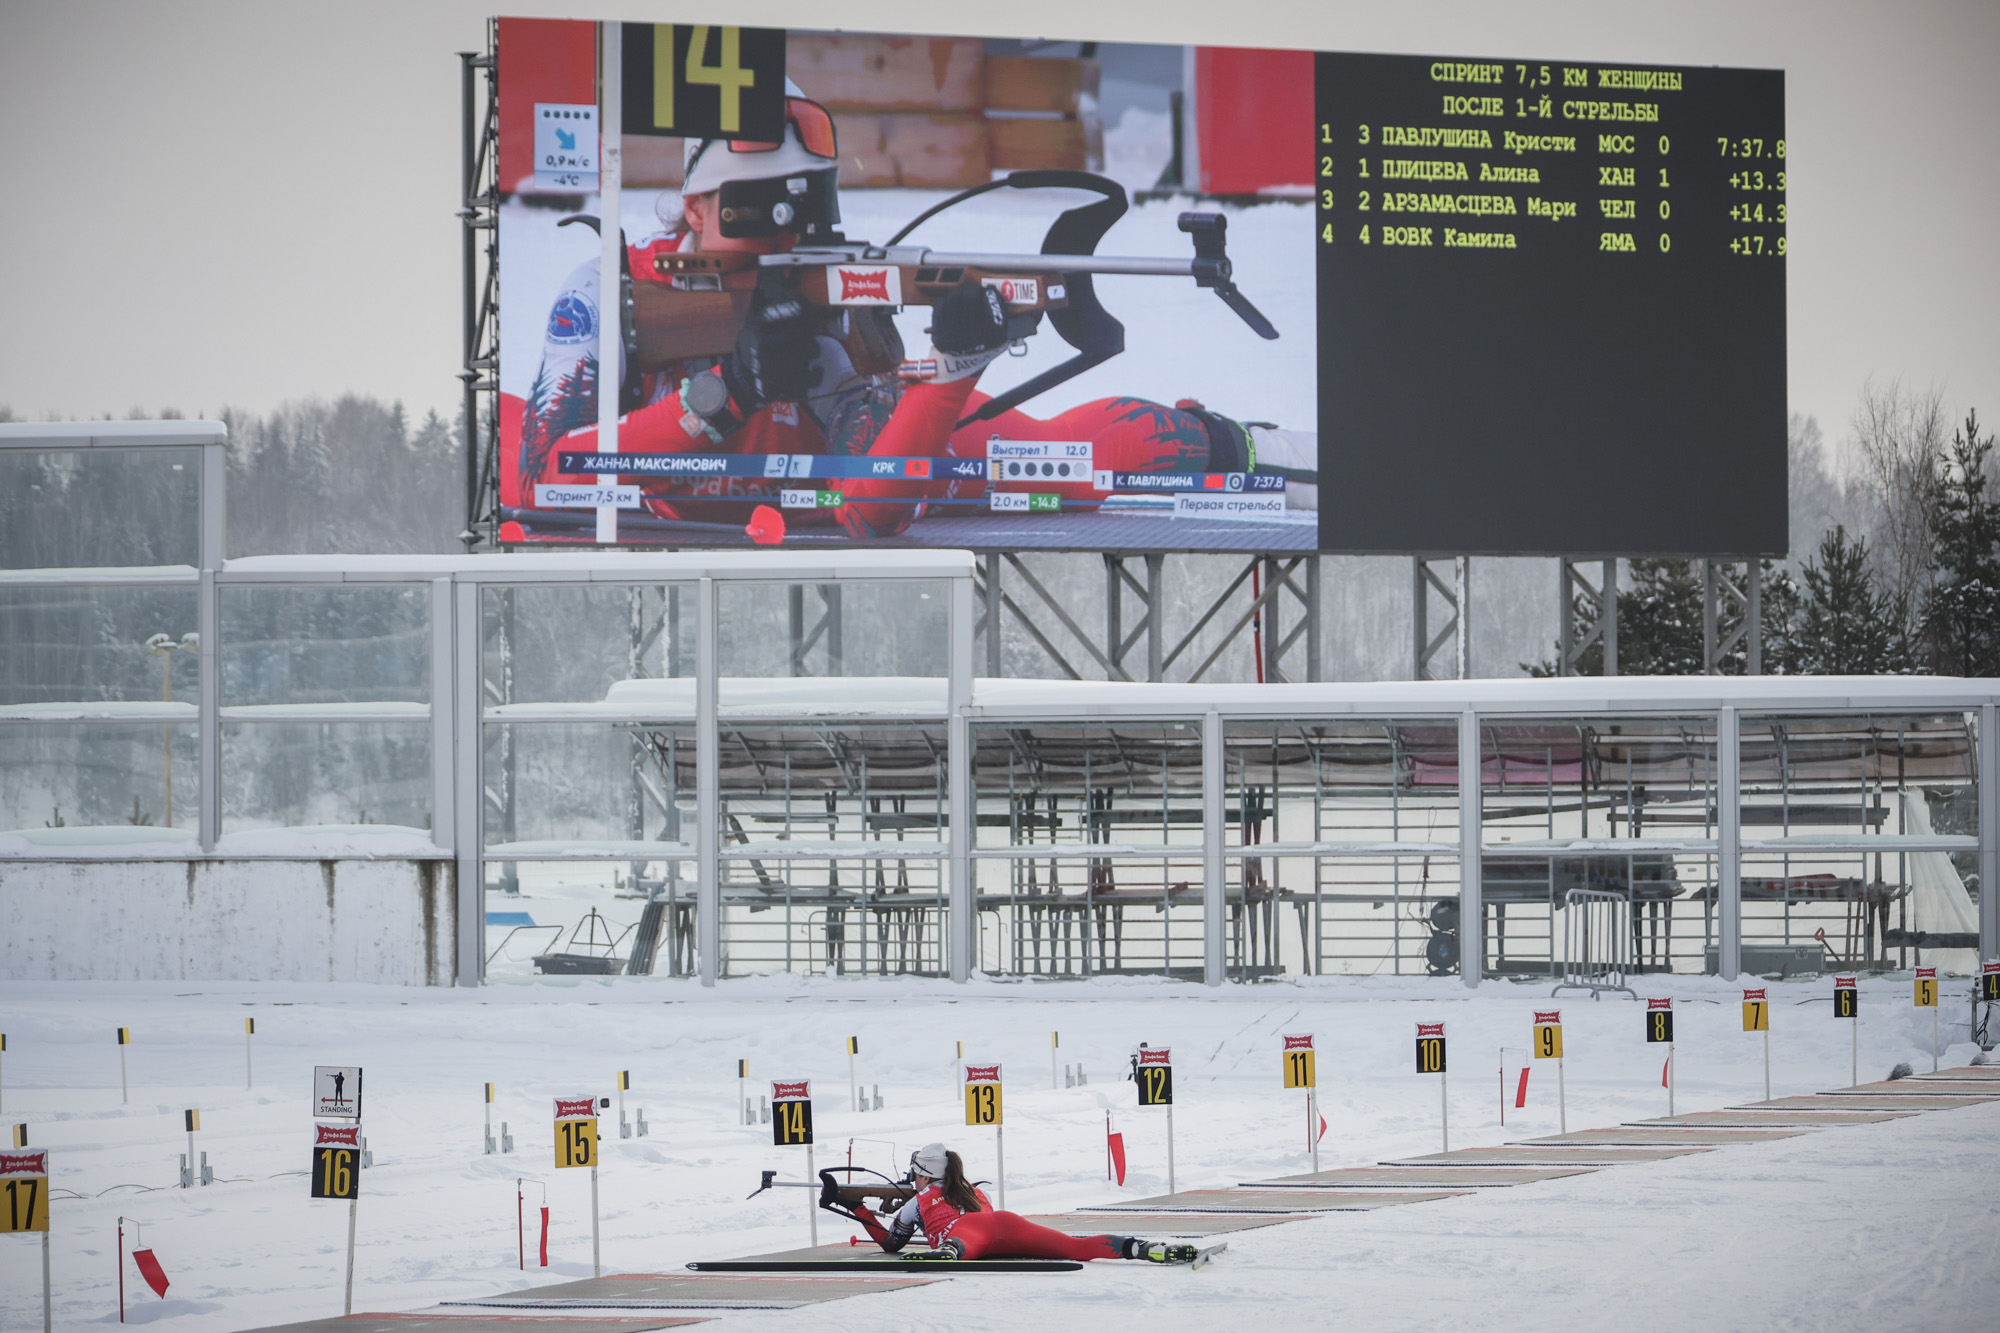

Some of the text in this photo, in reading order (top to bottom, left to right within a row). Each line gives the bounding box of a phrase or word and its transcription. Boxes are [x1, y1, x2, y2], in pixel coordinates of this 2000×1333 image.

[654, 23, 754, 132] 14
[1430, 62, 1682, 92] СПРИНТ 7,5 КМ ЖЕНЩИНЫ
[1442, 94, 1659, 122] ПОСЛЕ 1-Й СТРЕЛЬБЫ
[1321, 123, 1786, 159] 1 3 ПАВЛУШИНА Кристи МОС 0 7:37.8
[545, 155, 589, 168] 0,9 м/с
[1321, 156, 1786, 191] 2 1 ПЛИЦЕВА Алина ХАН 1 +13.3
[1321, 189, 1786, 223] 3 2 АРЗАМАСЦЕВА Мари ЧЕЛ 0 +14.3
[1322, 223, 1787, 256] 4 4 ВОВК Камила ЯМА 0 +17.9
[1014, 283, 1035, 300] TIME
[565, 456, 727, 471] 7 ЖАННА МАКСИМОВИЧ
[777, 457, 785, 467] 0
[992, 444, 1048, 457] Выстрел 1
[1066, 445, 1088, 456] 12.0
[872, 462, 896, 473] КРК
[1101, 475, 1106, 485] 1
[1127, 475, 1193, 487] ПАВЛУШИНА
[1232, 477, 1239, 488] 0
[546, 490, 632, 503] Спринт 7,5 км
[782, 492, 814, 505] 1.0 км
[818, 494, 841, 505] -2.6
[993, 496, 1027, 507] 2.0 км
[1031, 497, 1058, 508] -14.8
[1180, 498, 1282, 512] Первая стрельба
[1922, 980, 1930, 1005] 5
[1989, 974, 1998, 999] 4
[1751, 1002, 1760, 1030] 7
[1841, 990, 1850, 1017] 6
[1655, 1012, 1665, 1041] 8
[1543, 1026, 1553, 1057] 9
[1420, 1039, 1440, 1072] 10
[1290, 1052, 1308, 1086] 11
[1143, 1067, 1167, 1104] 12
[320, 1105, 353, 1114] STANDING
[971, 1085, 995, 1124] 13
[779, 1102, 806, 1143] 14
[562, 1122, 590, 1166] 15
[321, 1149, 352, 1197] 16
[5, 1179, 38, 1231] 17
